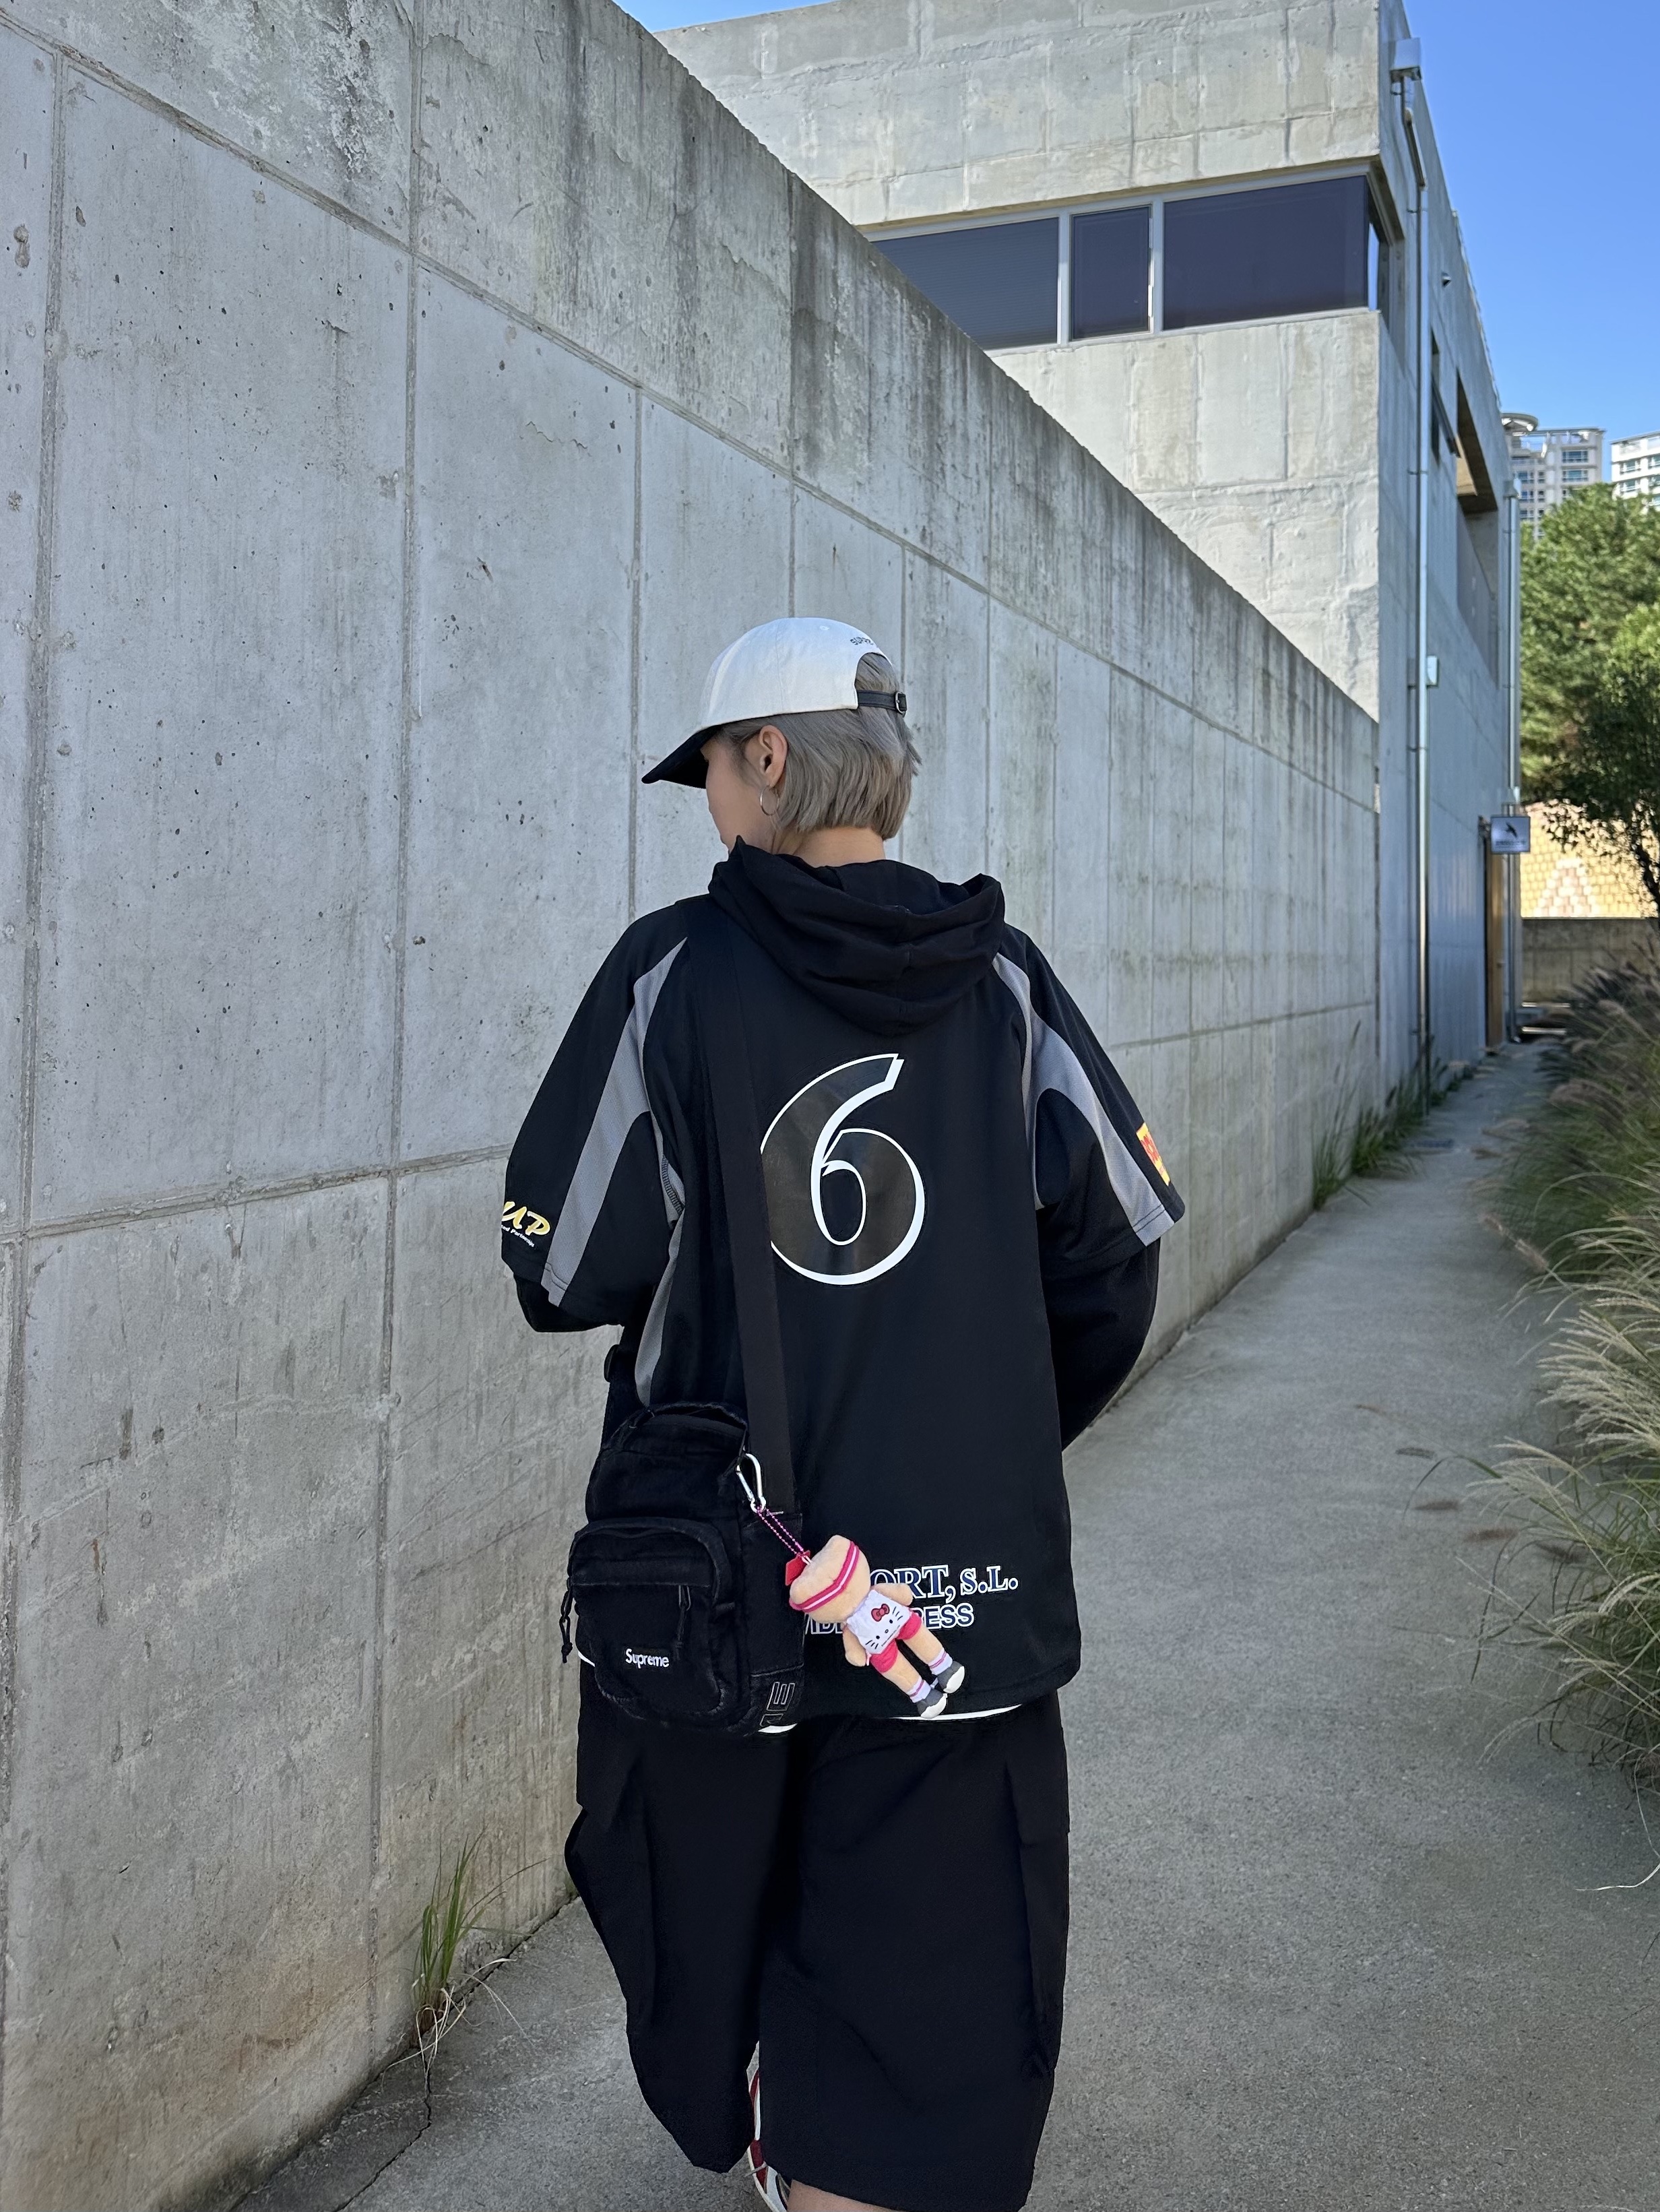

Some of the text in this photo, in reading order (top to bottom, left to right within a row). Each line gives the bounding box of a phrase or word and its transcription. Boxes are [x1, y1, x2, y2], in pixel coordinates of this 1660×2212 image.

[760, 1053, 925, 1285] 6
[960, 1565, 1019, 1596] S.L.
[625, 1648, 670, 1669] Supreme
